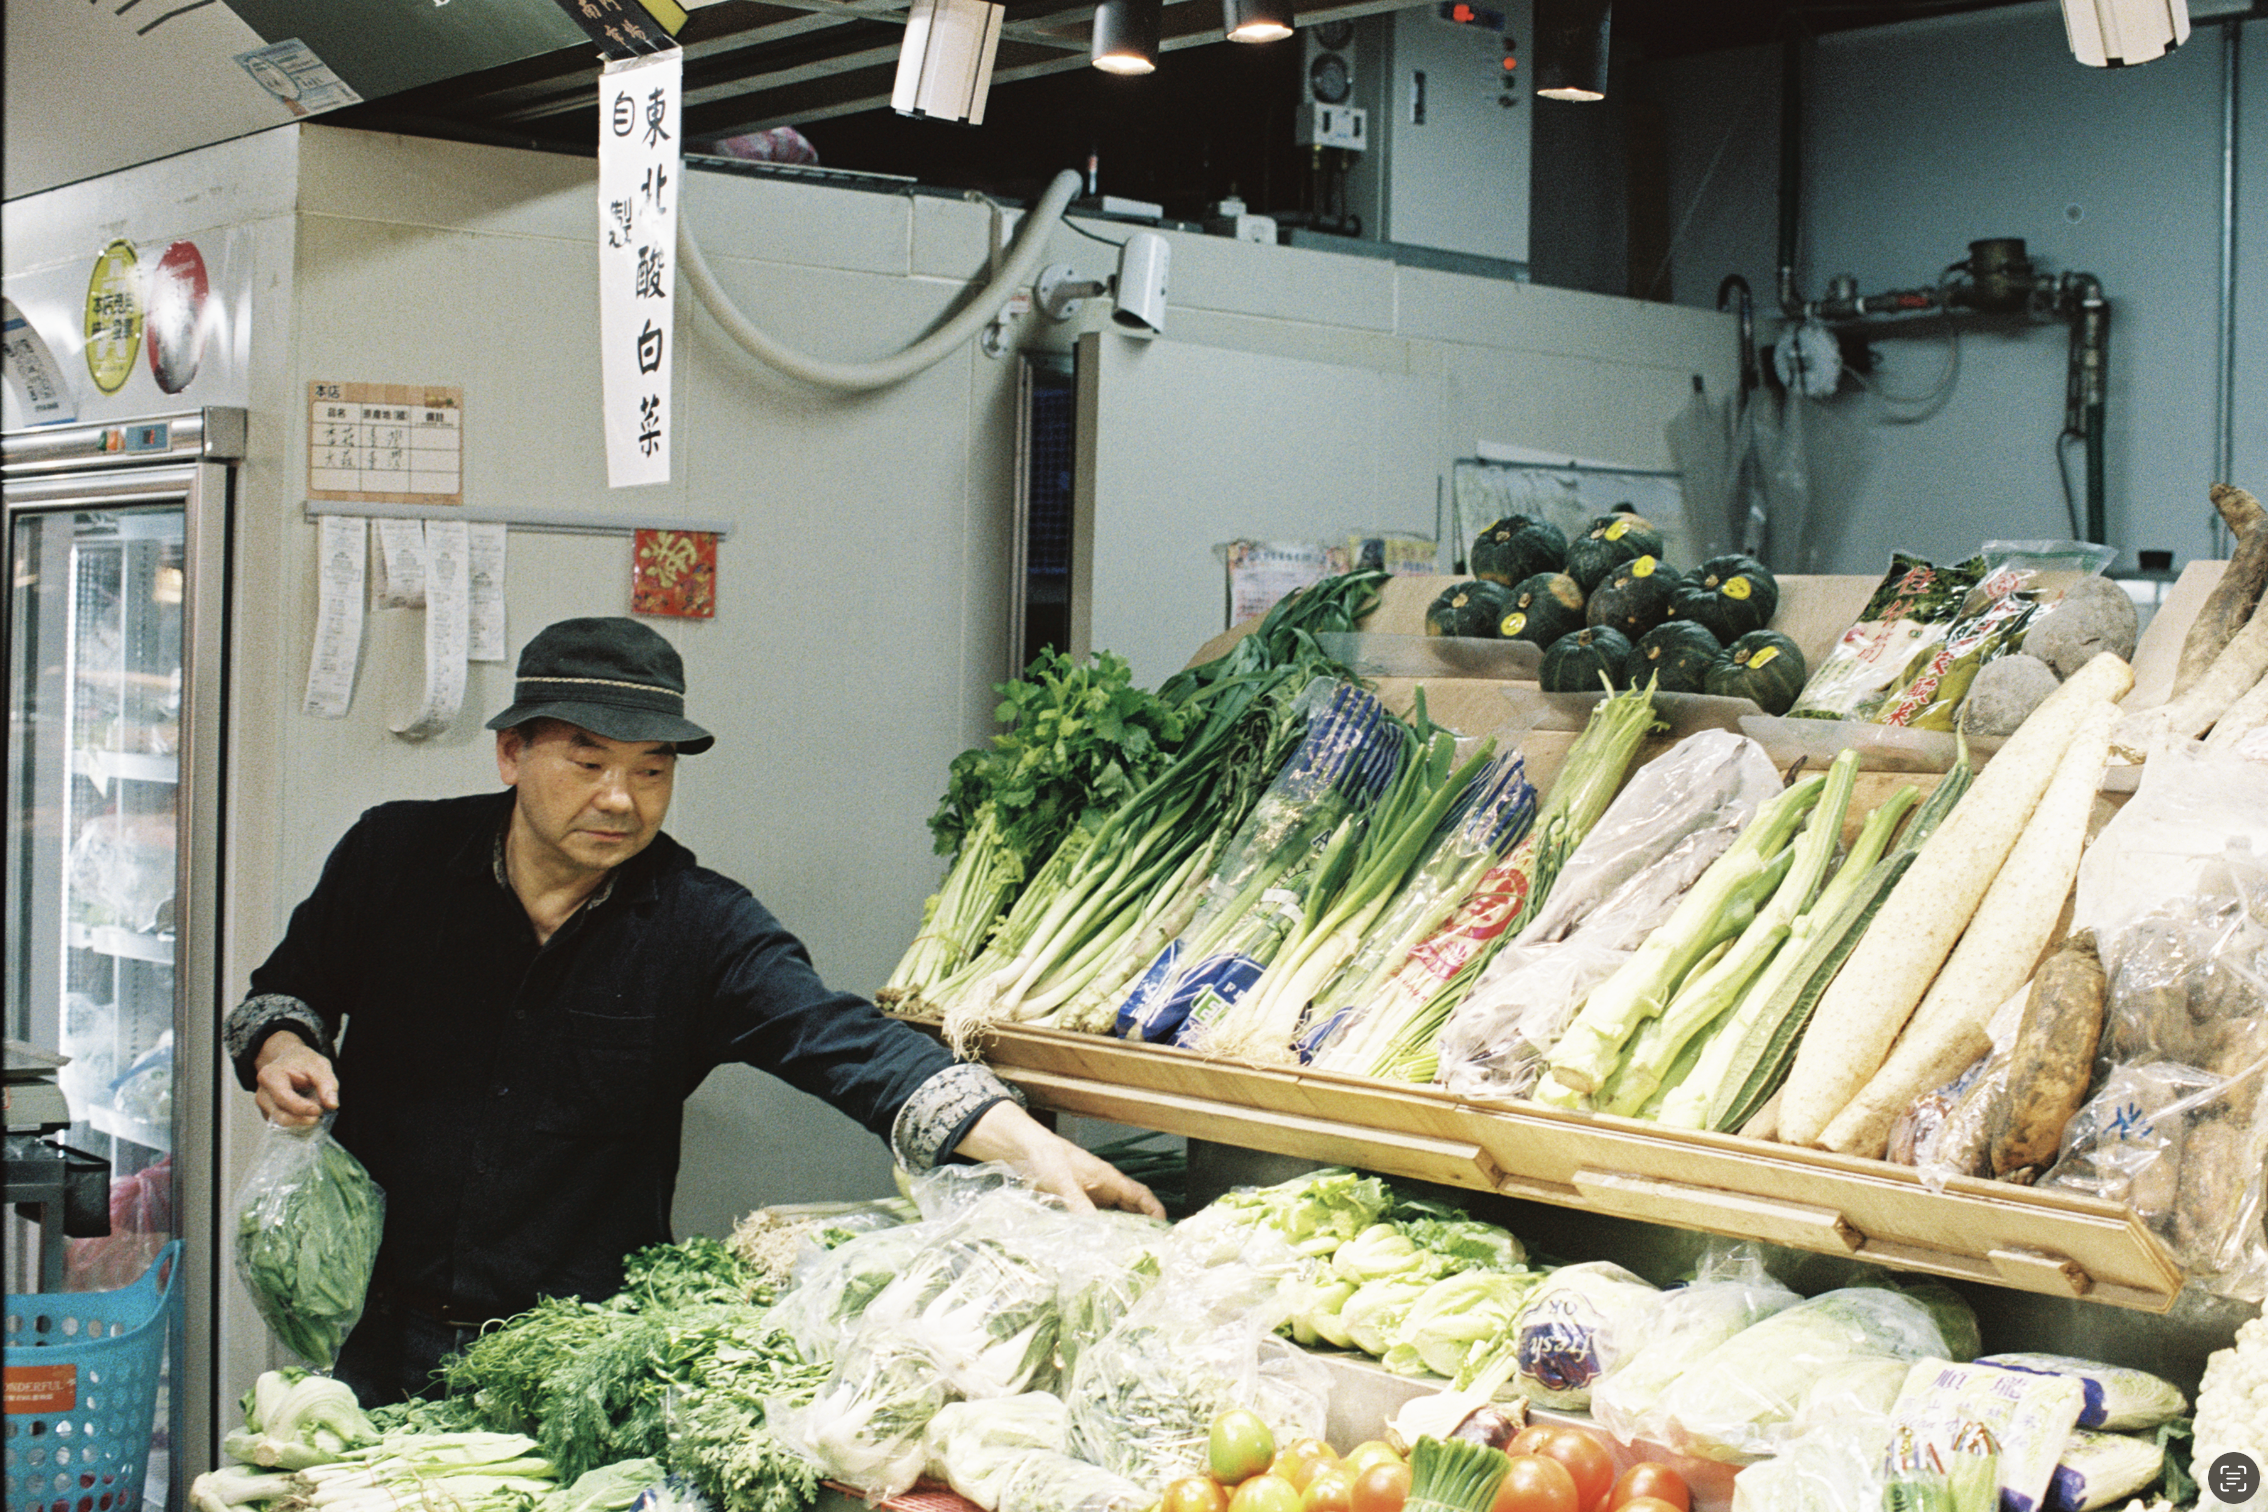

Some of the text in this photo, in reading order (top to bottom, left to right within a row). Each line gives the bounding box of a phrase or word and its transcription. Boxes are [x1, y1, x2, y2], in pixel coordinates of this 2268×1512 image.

[609, 91, 635, 247] 自製
[637, 87, 671, 458] 東北酸白菜
[315, 384, 340, 399] 本店
[327, 408, 346, 419] 品名
[1548, 1300, 1578, 1316] OK
[1530, 1333, 1593, 1365] fresh
